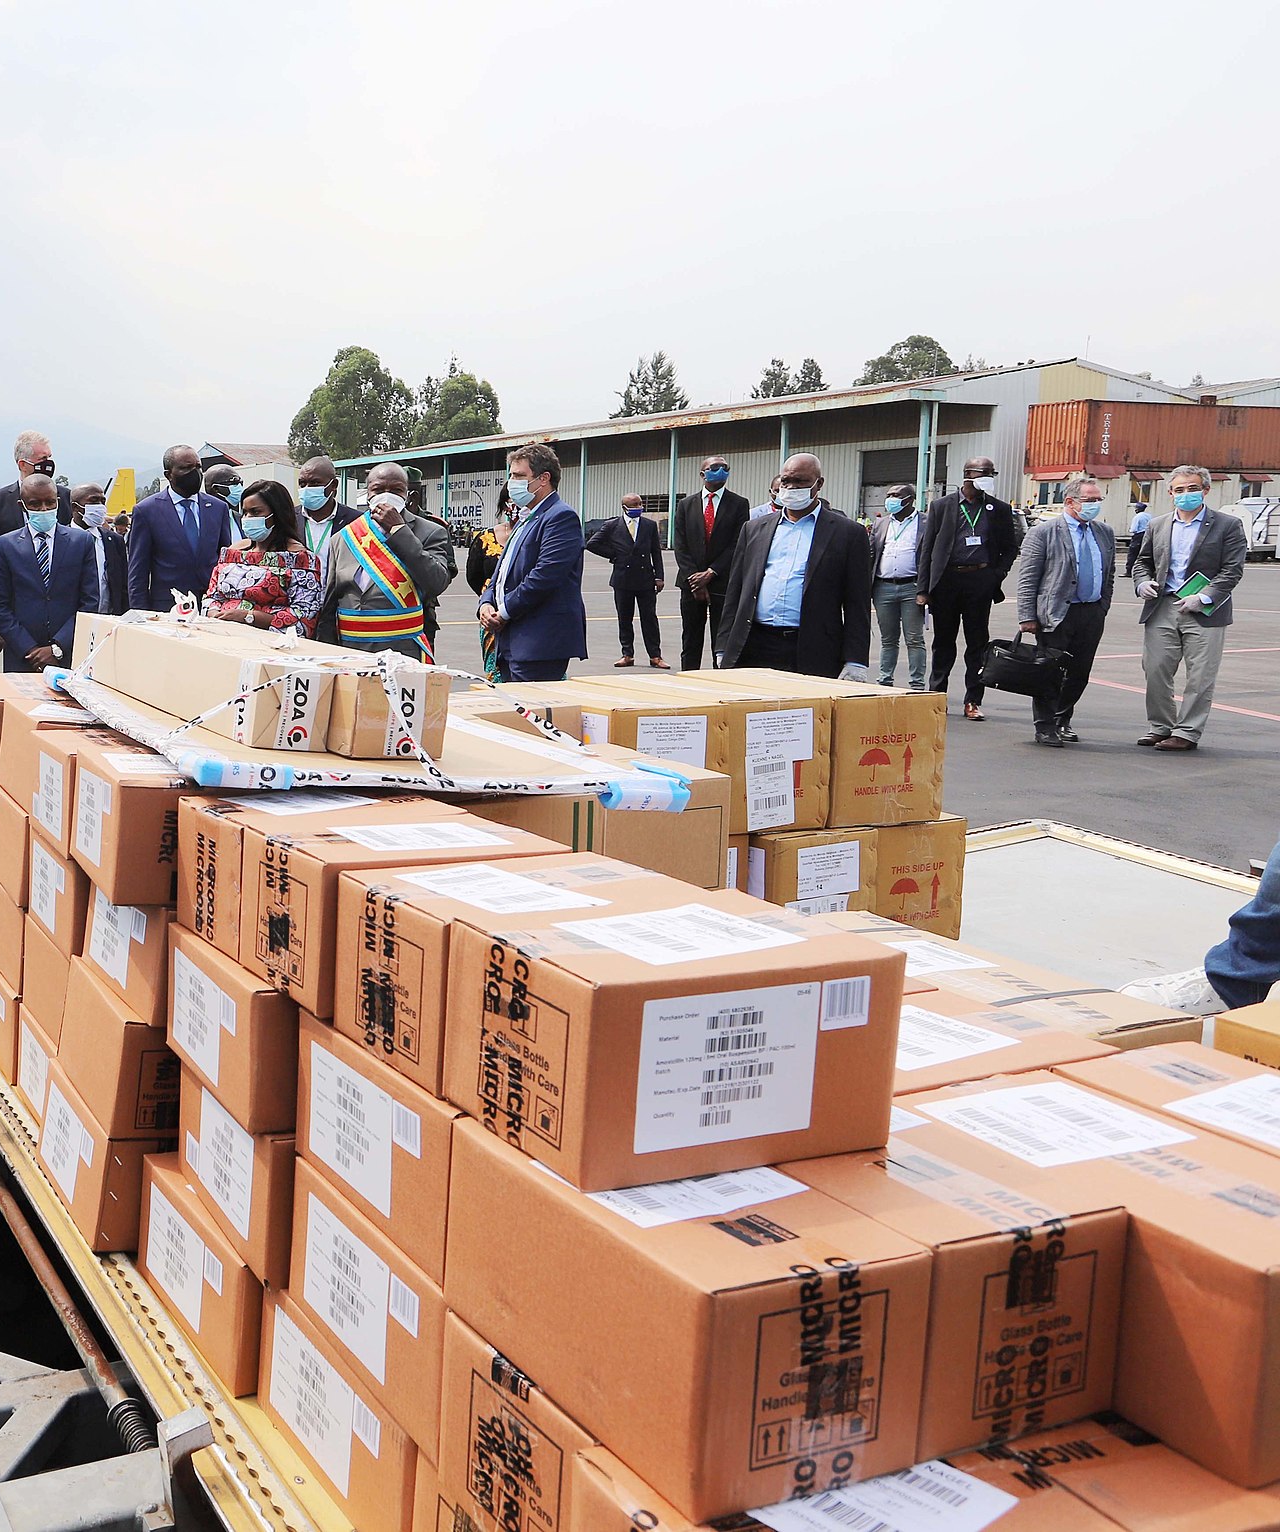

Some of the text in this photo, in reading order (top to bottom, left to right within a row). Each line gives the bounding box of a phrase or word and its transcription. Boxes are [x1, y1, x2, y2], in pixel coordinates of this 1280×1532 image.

[1101, 413, 1112, 455] TRITON
[437, 478, 503, 491] ENREPOT PUBLIC DE
[291, 677, 309, 721] ZOA
[860, 733, 917, 745] THIS SIDE UP
[854, 786, 879, 796] HANDLE
[898, 784, 914, 793] CARE
[891, 862, 945, 875] THIS SIDE UP
[925, 910, 940, 919] CARE
[400, 1002, 417, 1020] Care
[523, 1046, 550, 1072] Bottle
[537, 1074, 560, 1097] Care
[790, 1264, 823, 1367] MICRO
[824, 1257, 862, 1354] MICRO
[1000, 1314, 1072, 1341] Glass Bottle
[1056, 1330, 1083, 1346] Care
[924, 1464, 974, 1491] NAGEL
[529, 1499, 553, 1527] Care
